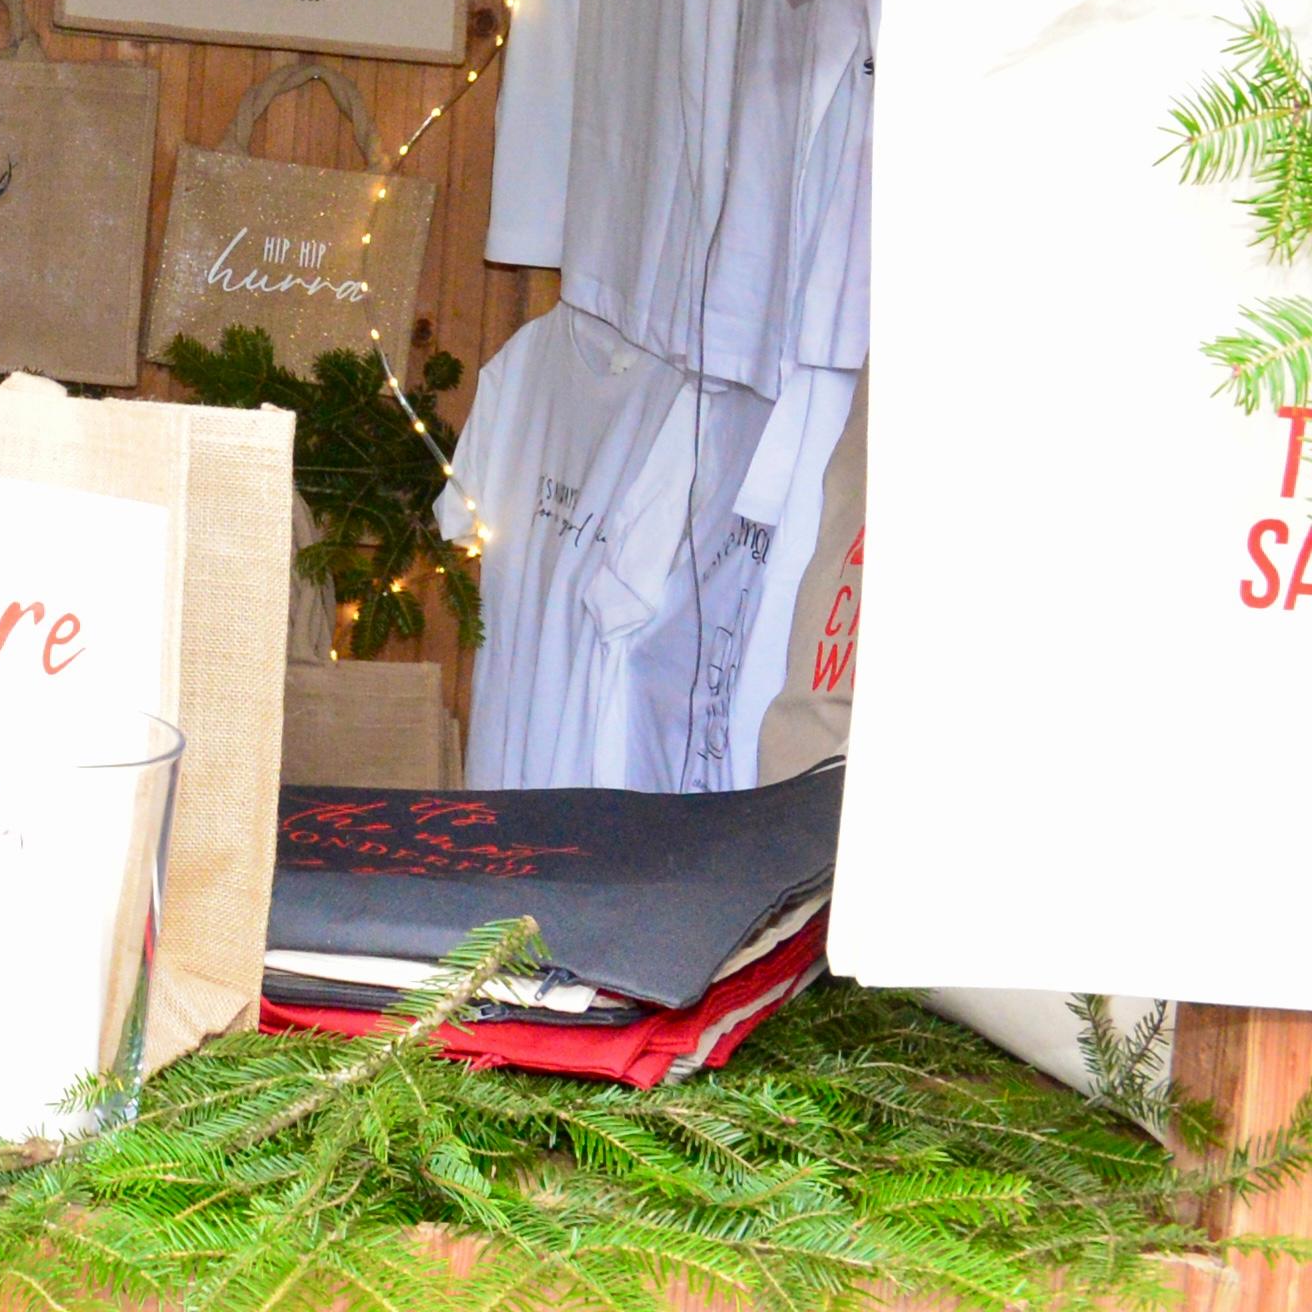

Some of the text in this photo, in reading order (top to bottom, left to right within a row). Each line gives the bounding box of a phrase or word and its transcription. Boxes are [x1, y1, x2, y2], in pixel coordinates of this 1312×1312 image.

[207, 226, 366, 303] hurra
[263, 237, 326, 269] HIP HIP
[287, 830, 539, 879] ONDERFUL
